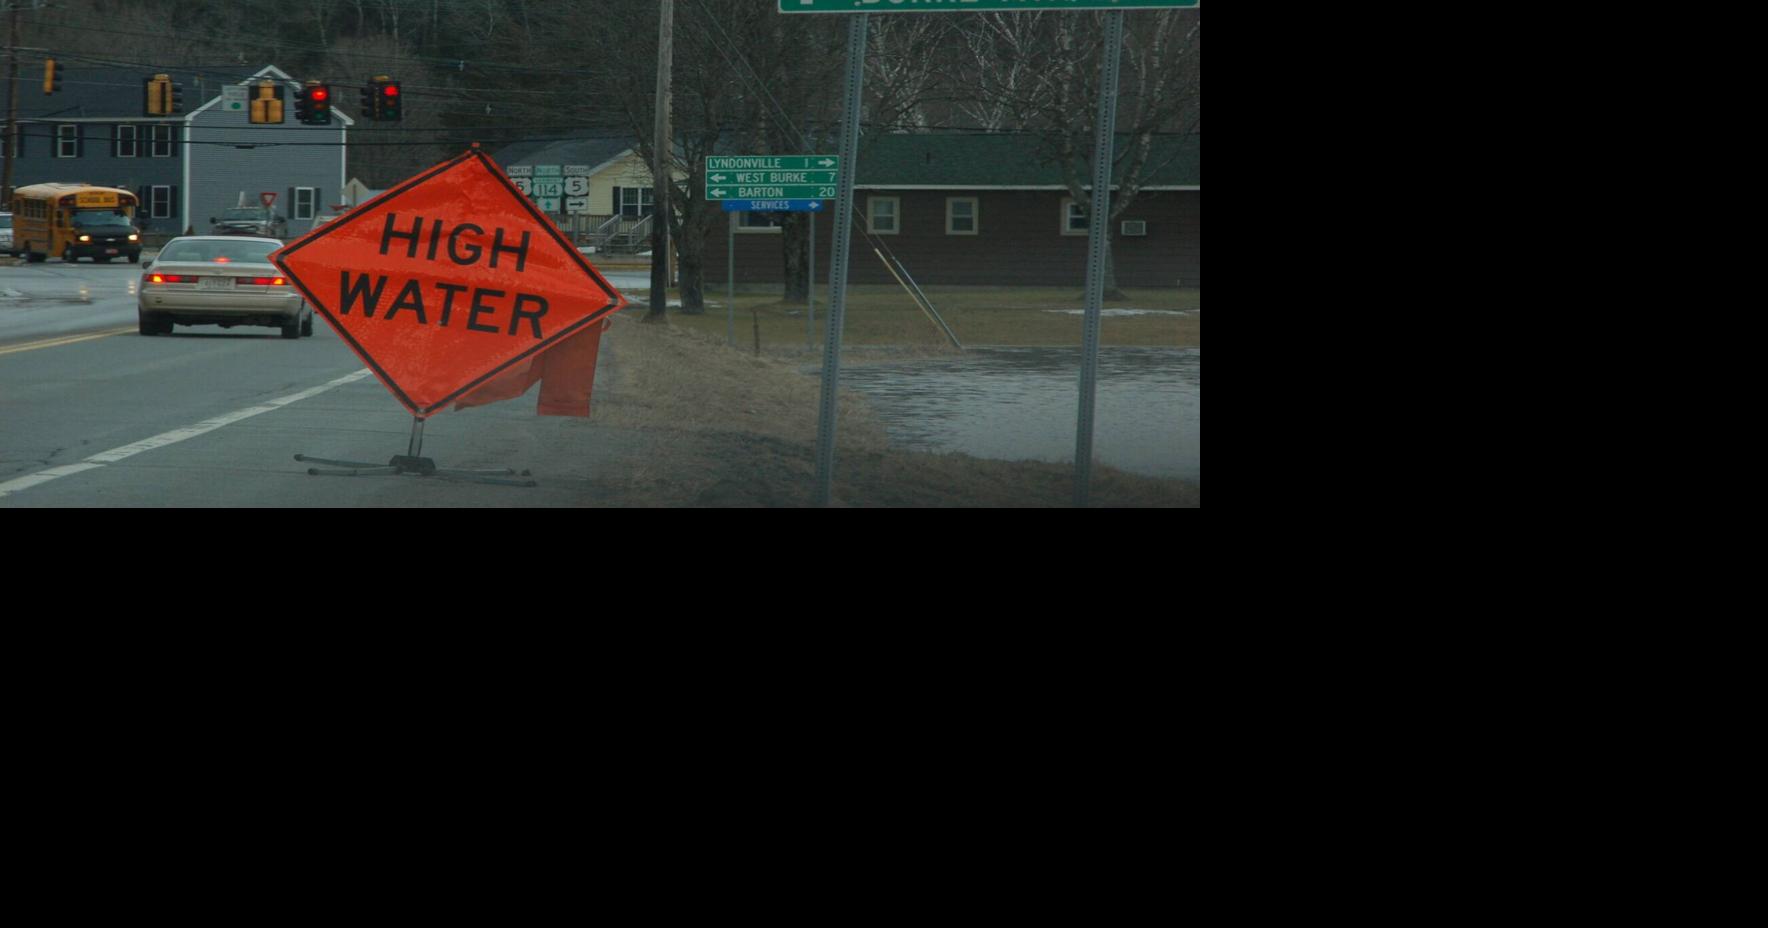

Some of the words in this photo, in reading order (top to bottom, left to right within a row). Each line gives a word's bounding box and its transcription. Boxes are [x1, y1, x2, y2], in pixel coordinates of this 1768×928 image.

[709, 158, 782, 169] LYNDONVILLE
[508, 166, 532, 174] NORTH
[736, 172, 765, 183] WEST
[770, 172, 807, 183] BURKE
[828, 172, 836, 183] 7
[538, 184, 558, 195] 114
[572, 180, 582, 192] 5
[738, 187, 784, 197] BARTON
[819, 187, 836, 197] 20
[751, 200, 790, 210] SERVICES
[379, 212, 531, 272] HIGH
[340, 270, 549, 340] WATER
